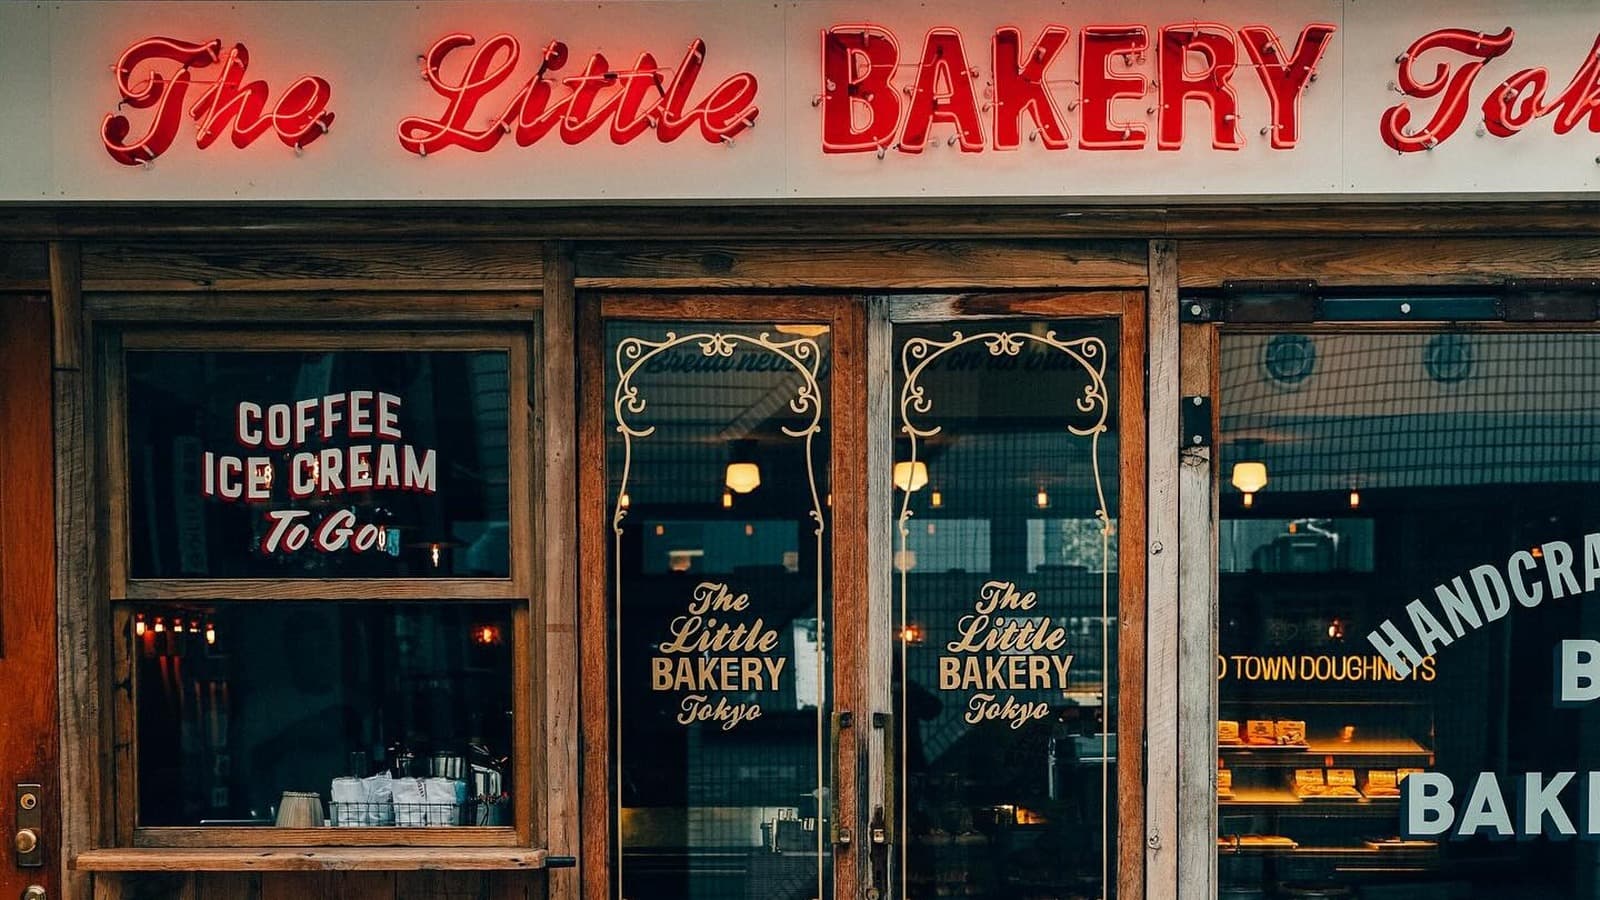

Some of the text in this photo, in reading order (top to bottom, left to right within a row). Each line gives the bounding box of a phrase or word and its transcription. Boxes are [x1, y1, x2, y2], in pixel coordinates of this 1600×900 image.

[101, 36, 334, 167] The
[399, 33, 760, 156] Little
[819, 23, 1337, 154] BAKERY
[236, 390, 402, 448] COFFEE
[203, 444, 437, 500] ICE CREAM
[262, 508, 378, 554] To Go
[688, 581, 750, 615] The
[975, 580, 1038, 615] The
[659, 616, 779, 654] Little
[947, 615, 1067, 653] Little
[652, 657, 786, 691] BAKERY
[939, 655, 1074, 690] BAKERY
[1230, 654, 1297, 681] TOWN
[677, 694, 762, 731] Tokyo
[964, 693, 1050, 730] Tokyo
